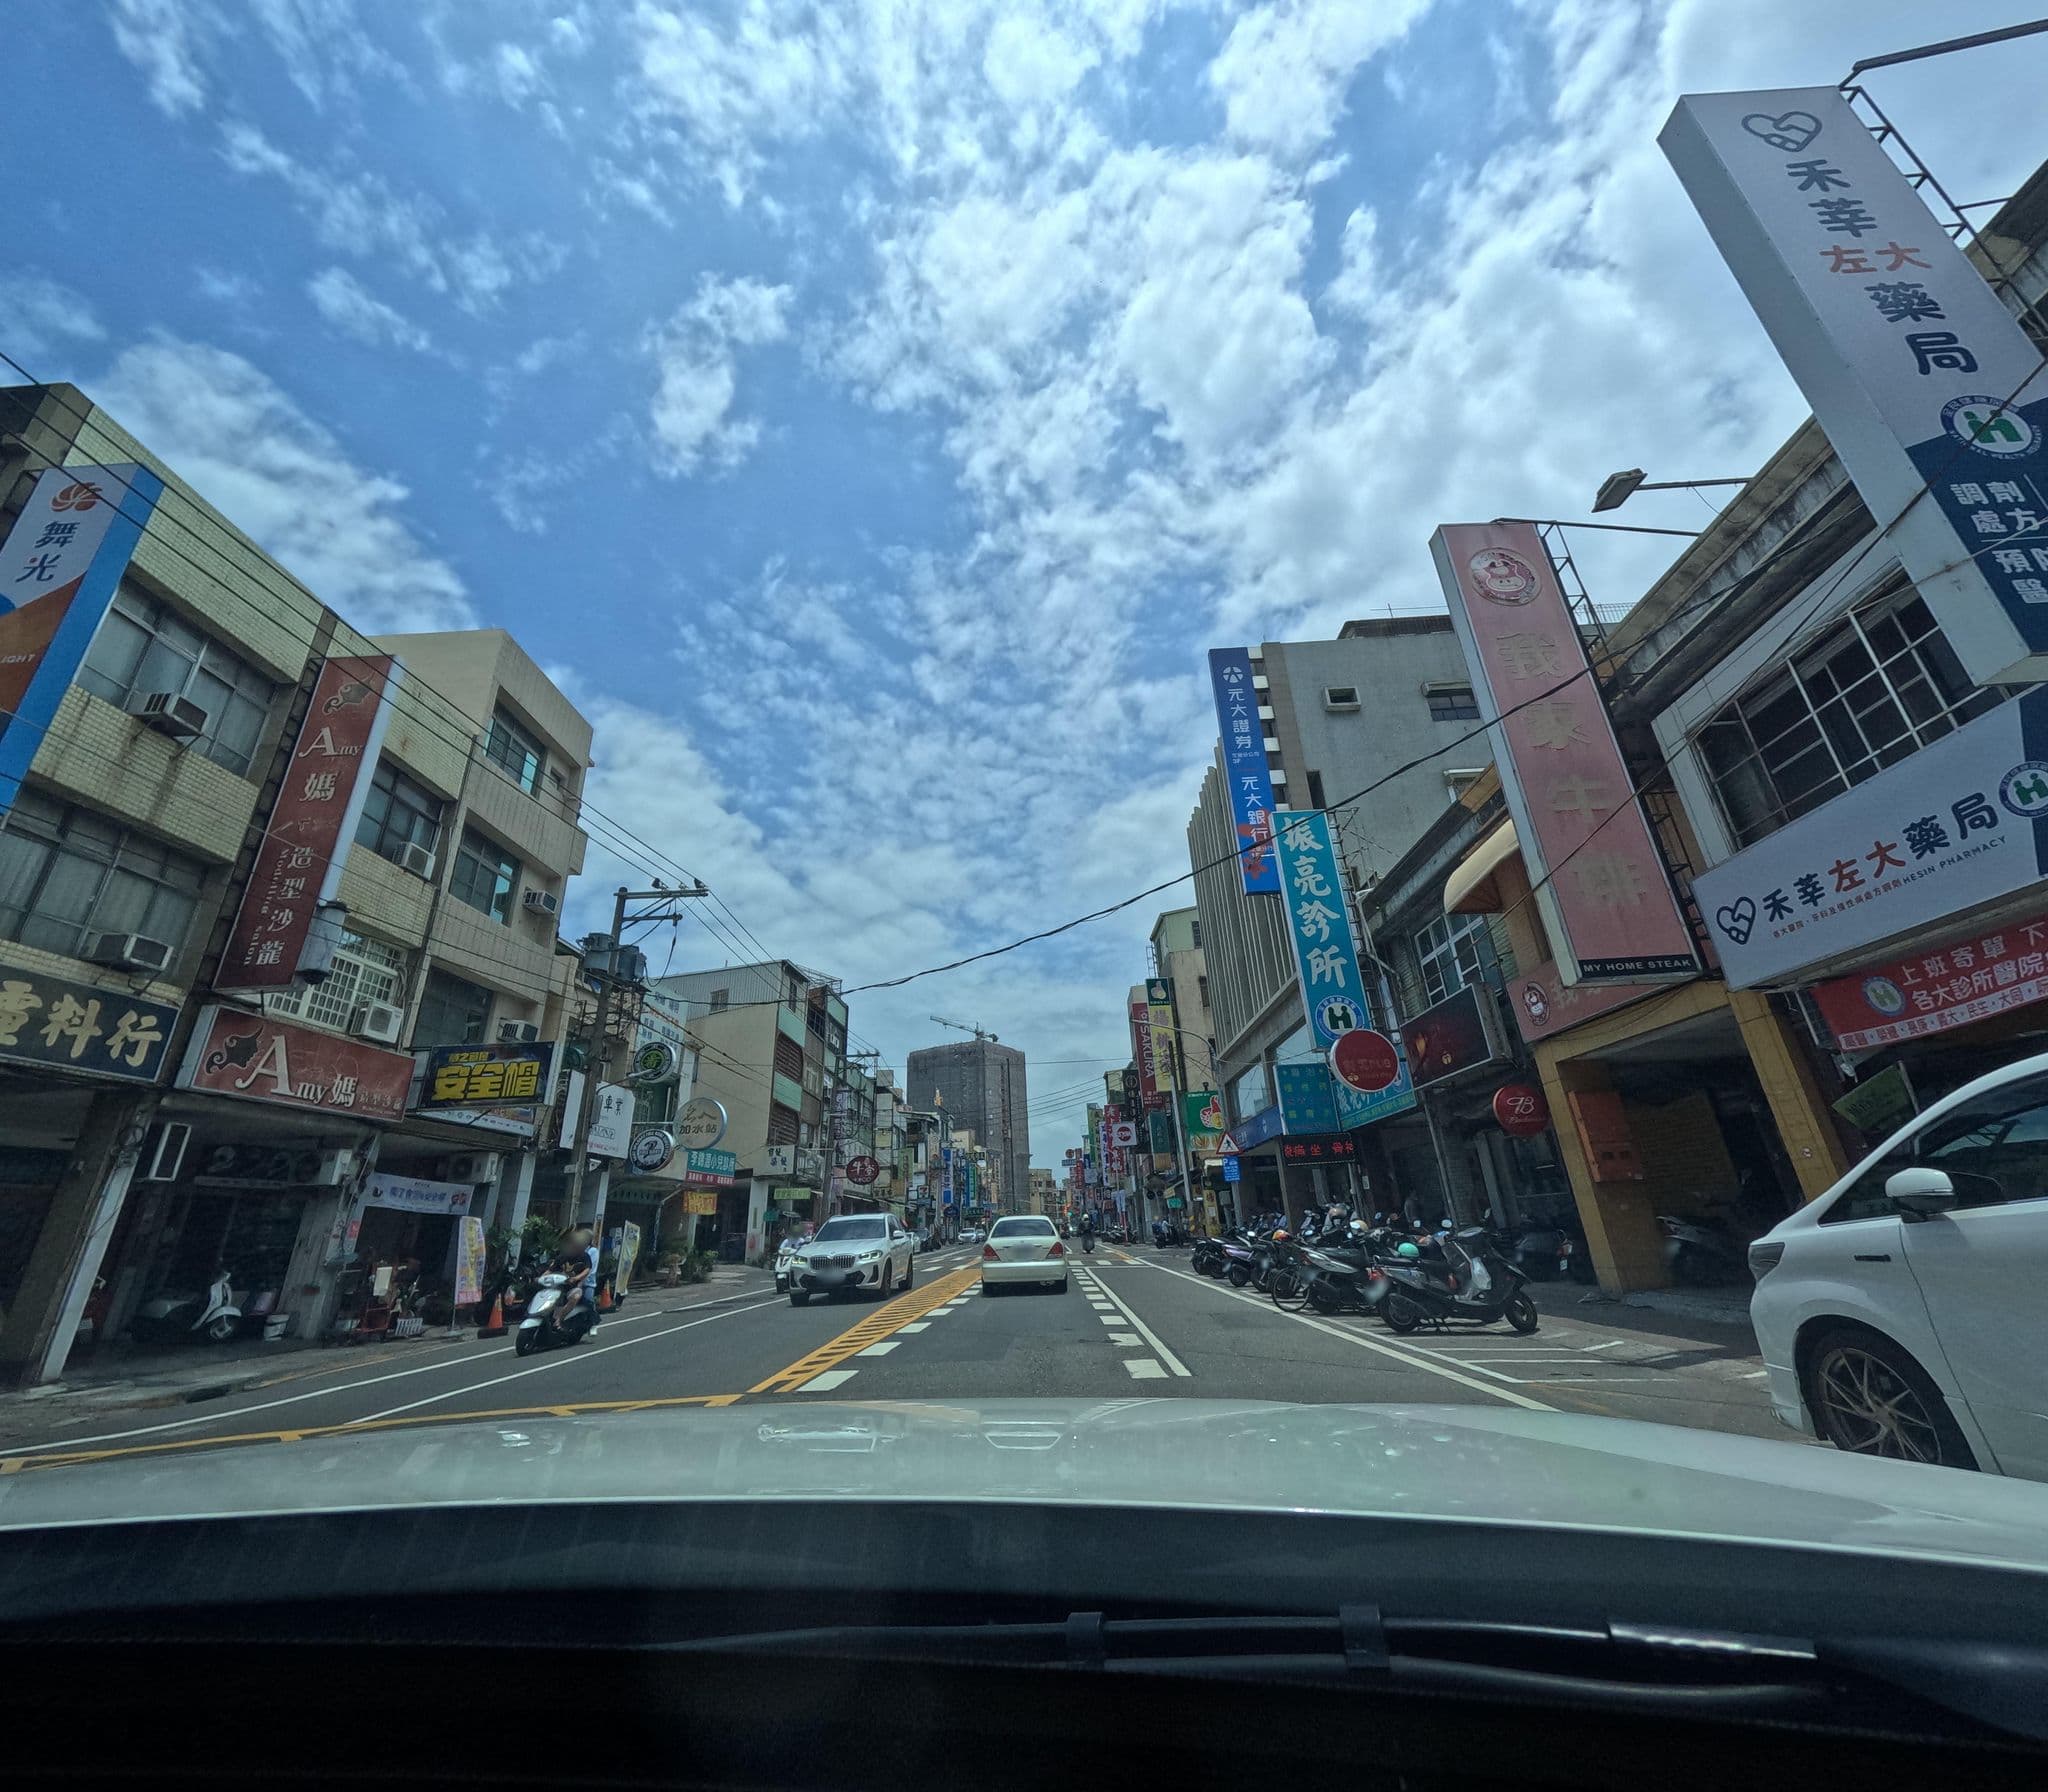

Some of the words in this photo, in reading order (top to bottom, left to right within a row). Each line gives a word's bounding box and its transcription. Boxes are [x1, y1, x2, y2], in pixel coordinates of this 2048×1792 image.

[15, 520, 81, 583] 舞光
[298, 726, 363, 758] Amy
[1227, 688, 1252, 749] 元大證券
[1241, 776, 1269, 844] 元大銀行
[1904, 864, 1935, 885] HESIN
[1938, 836, 2007, 869] PHARMACY
[255, 846, 314, 966] 造型沙龍
[1282, 817, 1348, 989] 振亮診所
[1583, 962, 1601, 972] MY
[1606, 960, 1644, 971] HOME
[1648, 958, 1692, 970] STEAK
[1911, 951, 2048, 1011] 各大診所醫院
[234, 1033, 328, 1106] Amy
[432, 1061, 541, 1101] 安全帽
[1139, 1024, 1155, 1079] SAKURA
